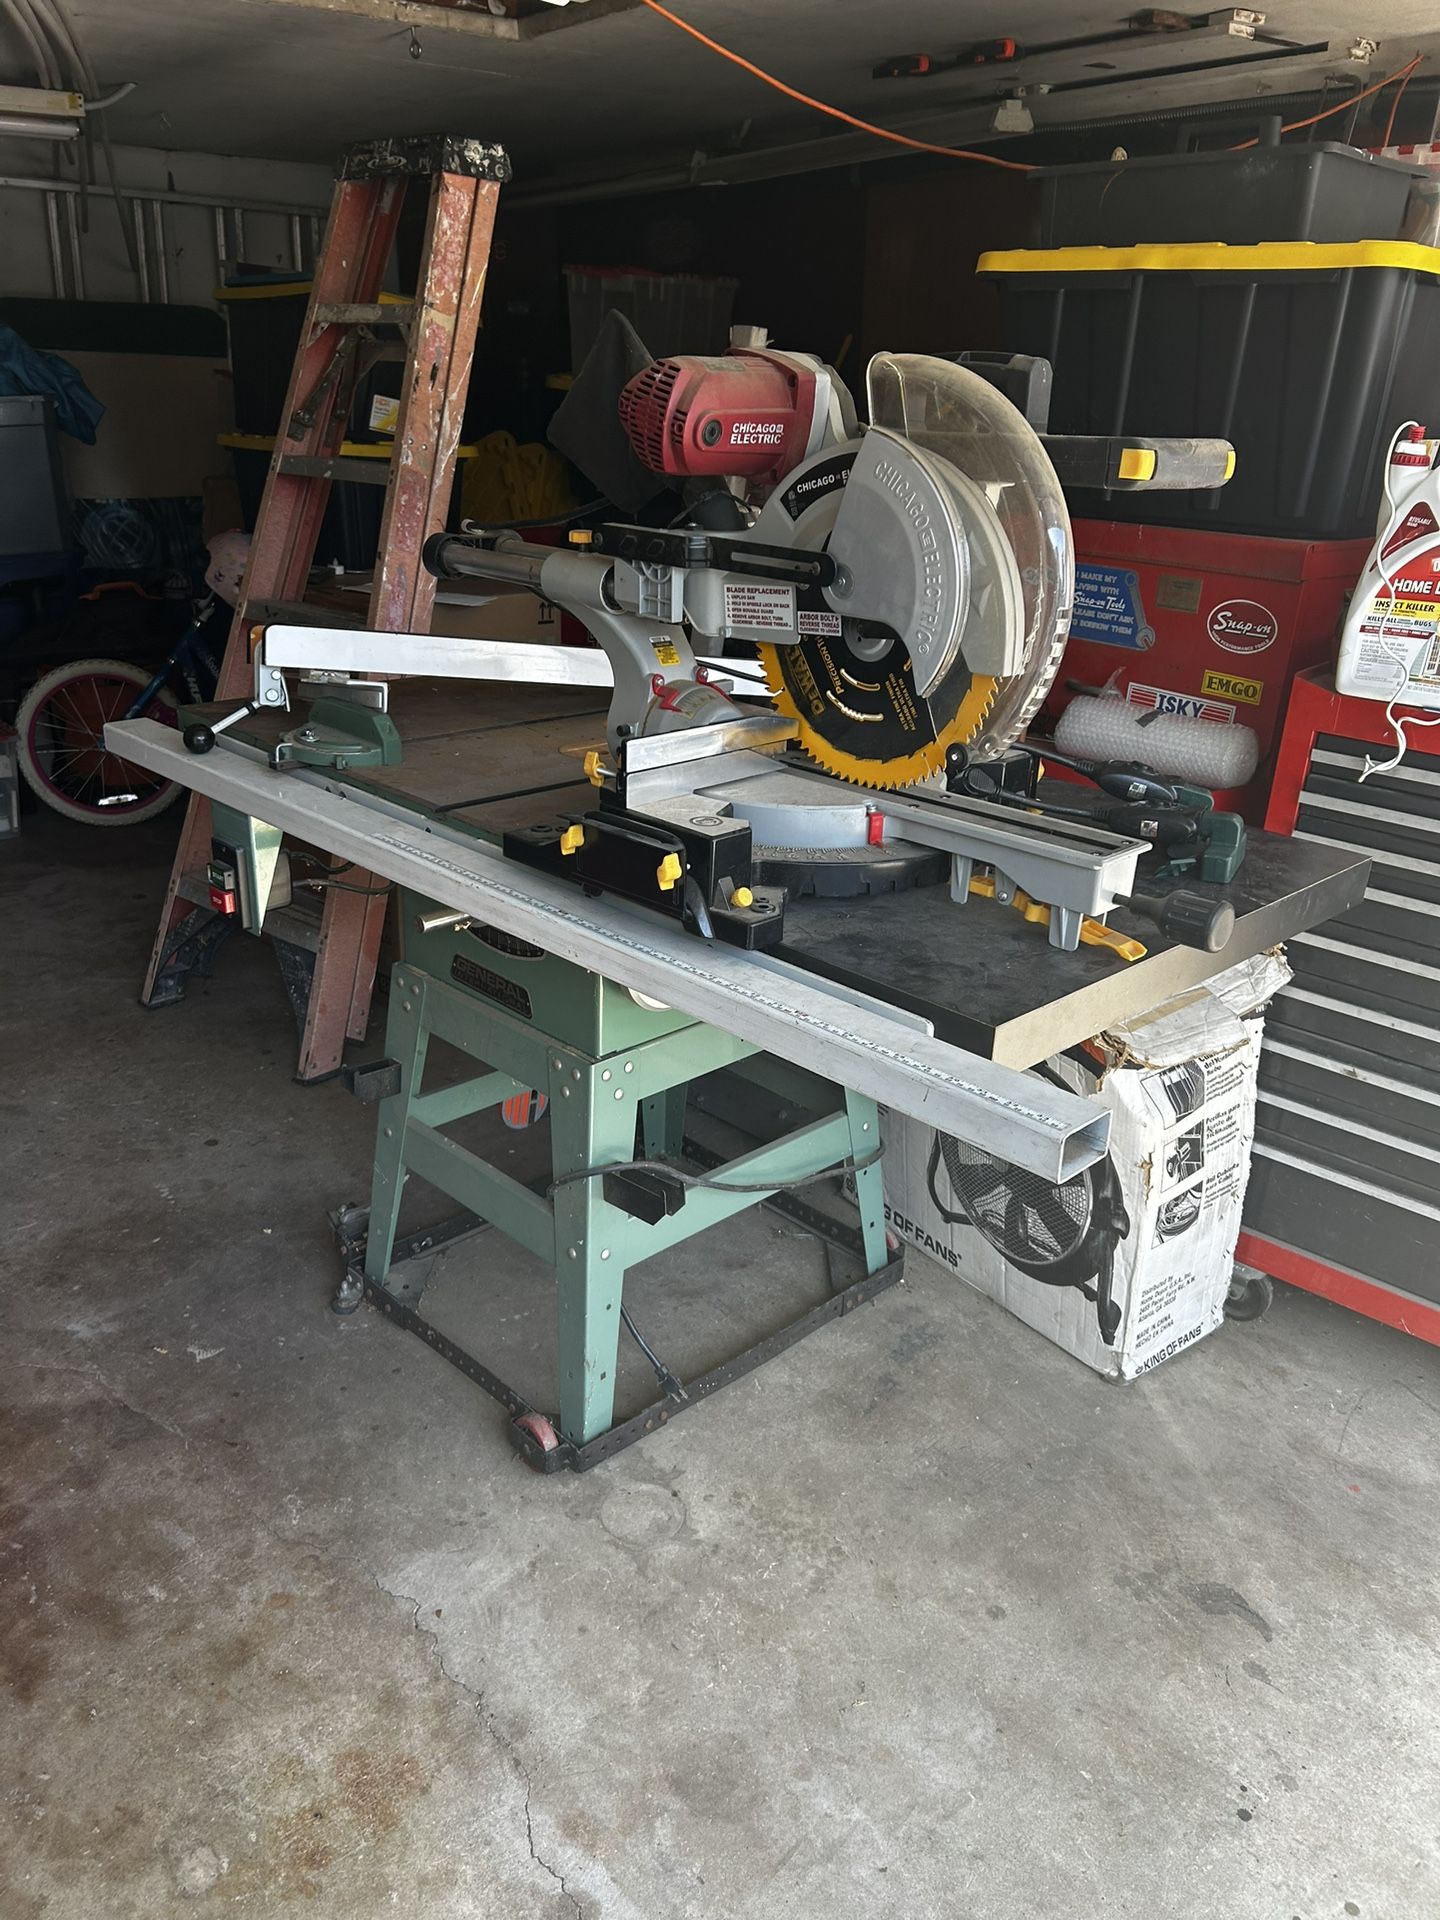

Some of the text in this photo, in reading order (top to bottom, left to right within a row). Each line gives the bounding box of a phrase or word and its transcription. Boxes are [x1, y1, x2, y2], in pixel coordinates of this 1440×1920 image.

[732, 422, 776, 433] CHICAGO
[730, 434, 781, 444] ELECTRIC
[796, 474, 835, 494] CHICAGO
[874, 461, 931, 529] CHICAGO
[1081, 572, 1103, 581] MAKE
[1104, 575, 1117, 583] MY
[1394, 578, 1433, 594] HOME
[1100, 586, 1119, 595] WITH
[1074, 592, 1125, 612] Snap-on Tools
[1375, 600, 1435, 612] INSCT KILLER
[1074, 608, 1095, 617] LEASE
[1111, 625, 1132, 635] THEM
[1213, 611, 1271, 638] Snap-on
[1206, 676, 1258, 698] EMGO
[1157, 694, 1206, 718] ISKY
[457, 960, 521, 999] GENERAL
[893, 1210, 914, 1233] OF
[915, 1225, 958, 1268] FANS
[1141, 1295, 1153, 1305] Home
[1143, 1325, 1201, 1370] KING OF FANS
